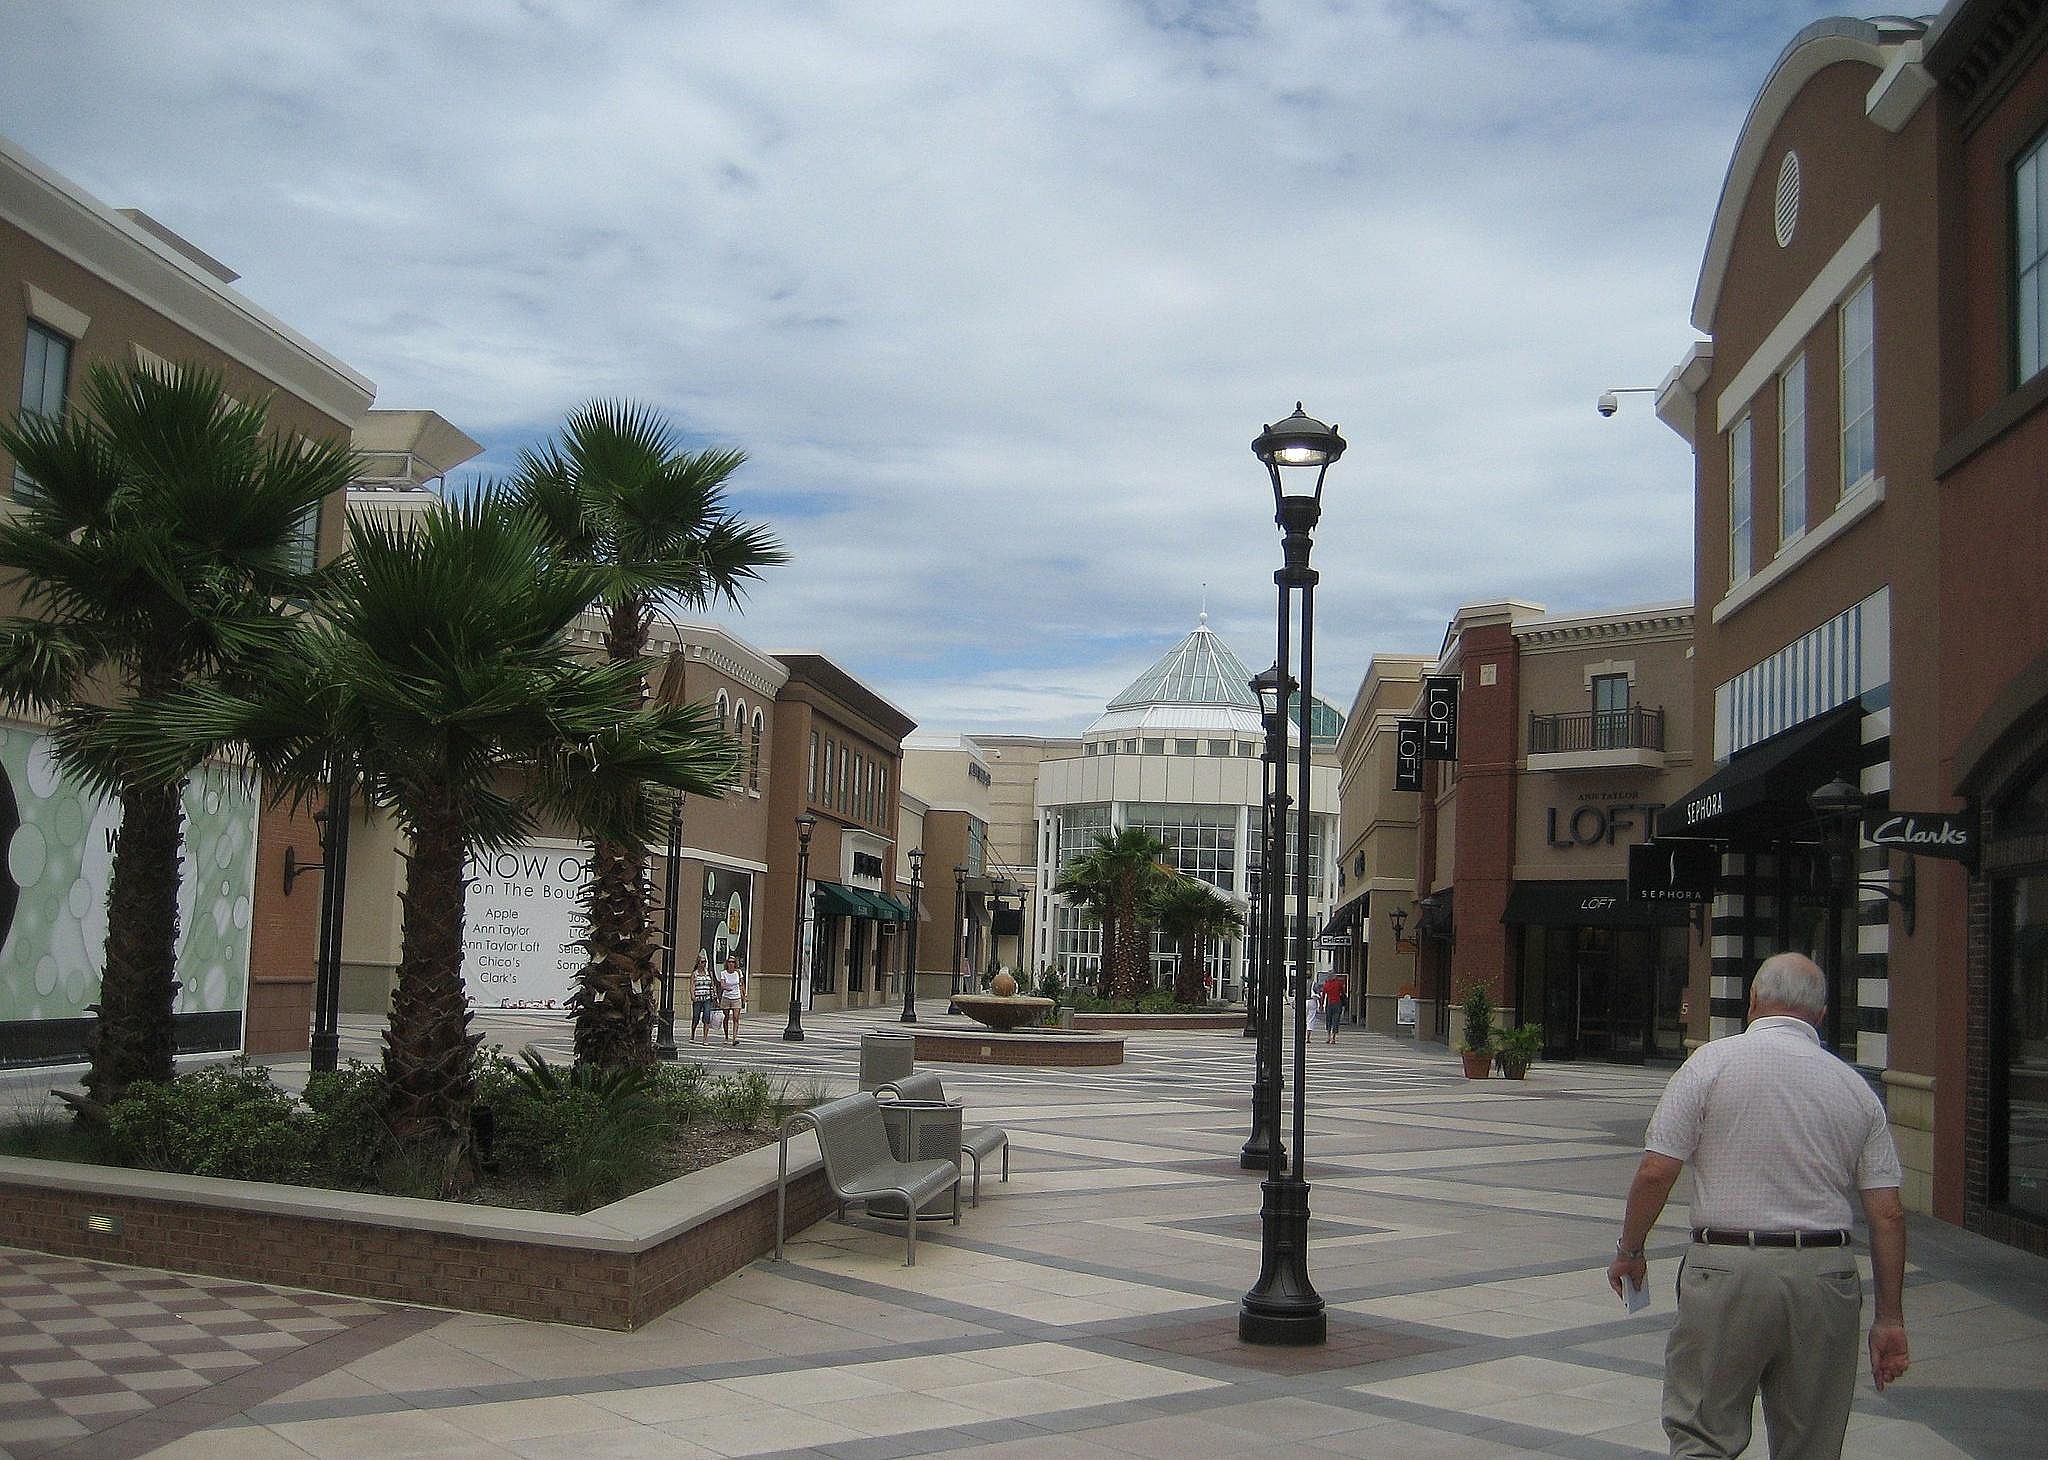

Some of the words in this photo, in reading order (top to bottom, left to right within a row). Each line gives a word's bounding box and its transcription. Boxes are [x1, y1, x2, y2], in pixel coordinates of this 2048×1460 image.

[1429, 687, 1449, 751] LOFT
[1400, 729, 1417, 783] LOFT
[1687, 791, 1722, 825] SEPHORA
[1546, 802, 1666, 849] LOFT
[1872, 816, 1967, 845] Clarks
[473, 852, 549, 880] NOW
[472, 883, 494, 895] on
[503, 882, 534, 897] The
[543, 884, 576, 899] Bou
[1641, 890, 1701, 899] SEPHORA
[1580, 897, 1616, 910] LOFT
[486, 908, 519, 921] Apple
[472, 924, 495, 935] Ann
[498, 925, 530, 937] Taylor
[461, 940, 482, 950] Ann
[486, 940, 517, 952] Taylor
[520, 942, 540, 952] Loft
[558, 943, 588, 954] Selec
[478, 956, 520, 968] Chico's
[480, 972, 517, 984] Clark's
